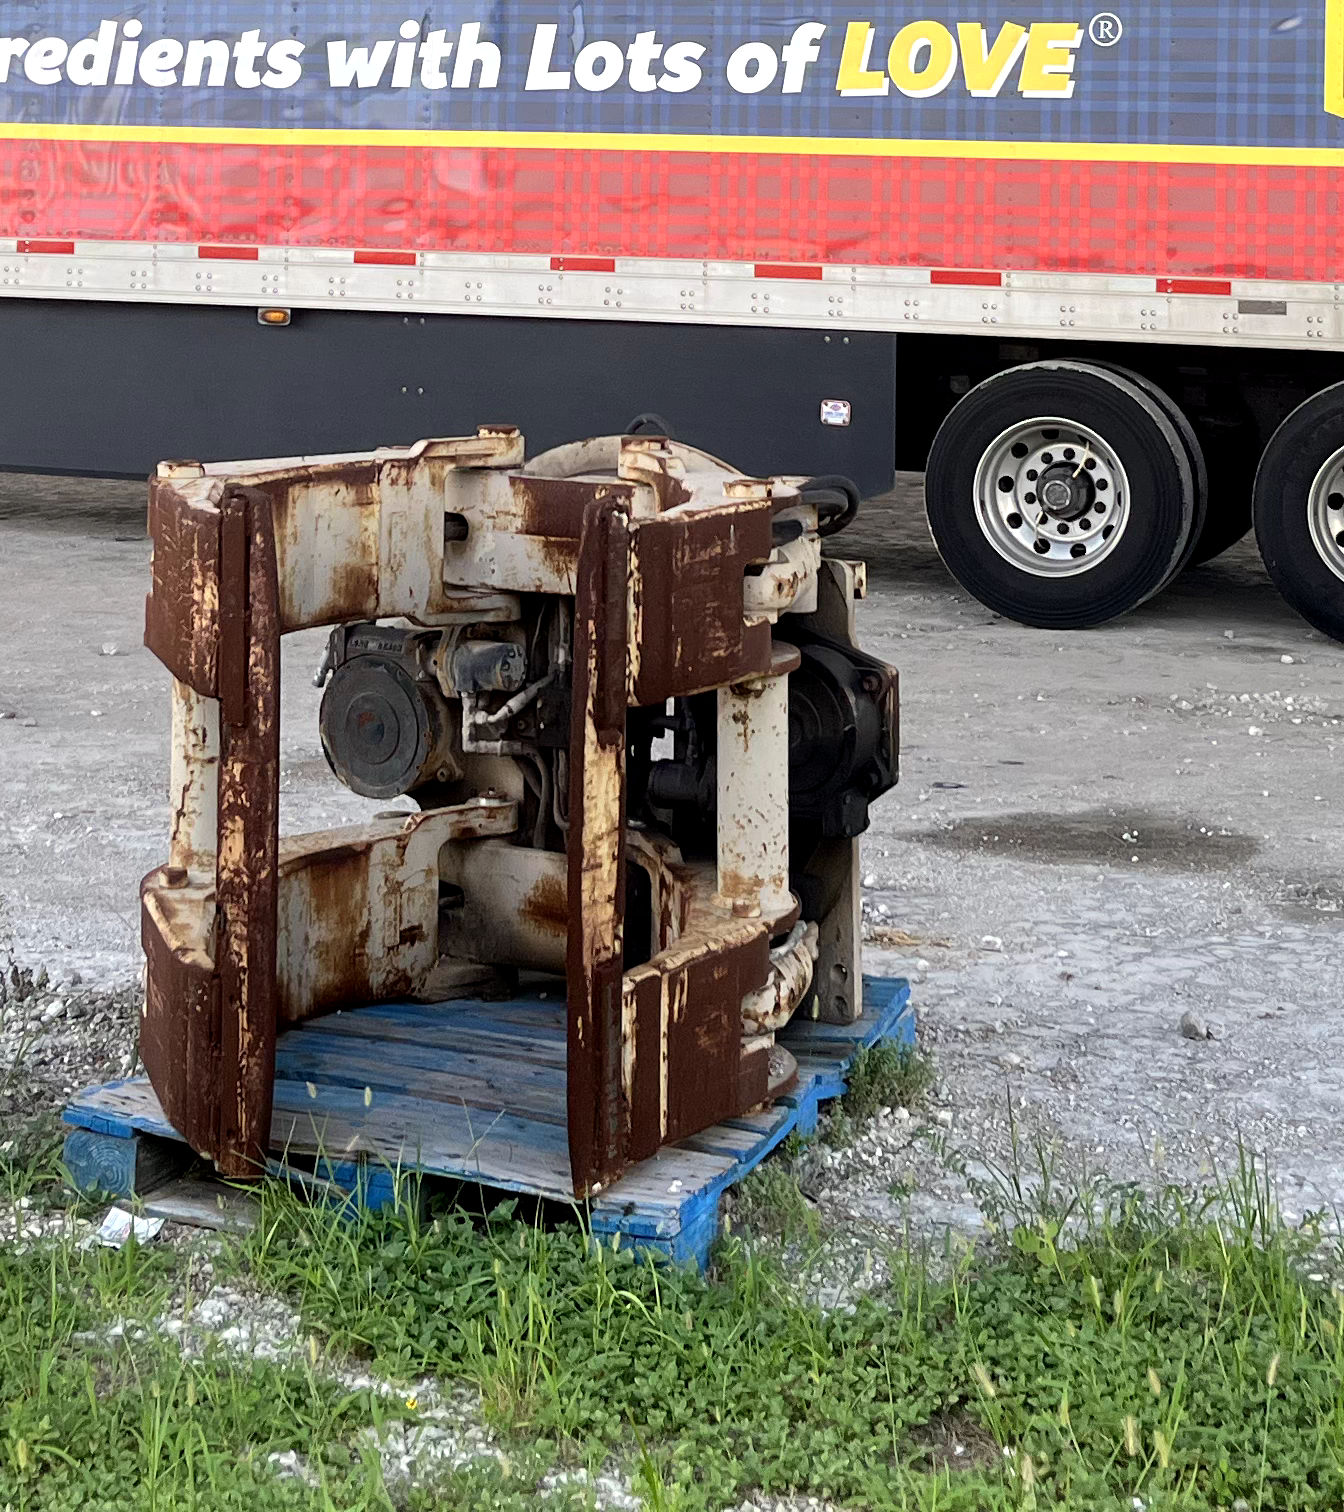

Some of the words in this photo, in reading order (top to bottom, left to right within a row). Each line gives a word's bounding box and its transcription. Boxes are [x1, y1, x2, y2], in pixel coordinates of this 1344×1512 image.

[326, 19, 501, 90] with
[523, 23, 707, 93] Lots
[725, 21, 828, 94] of
